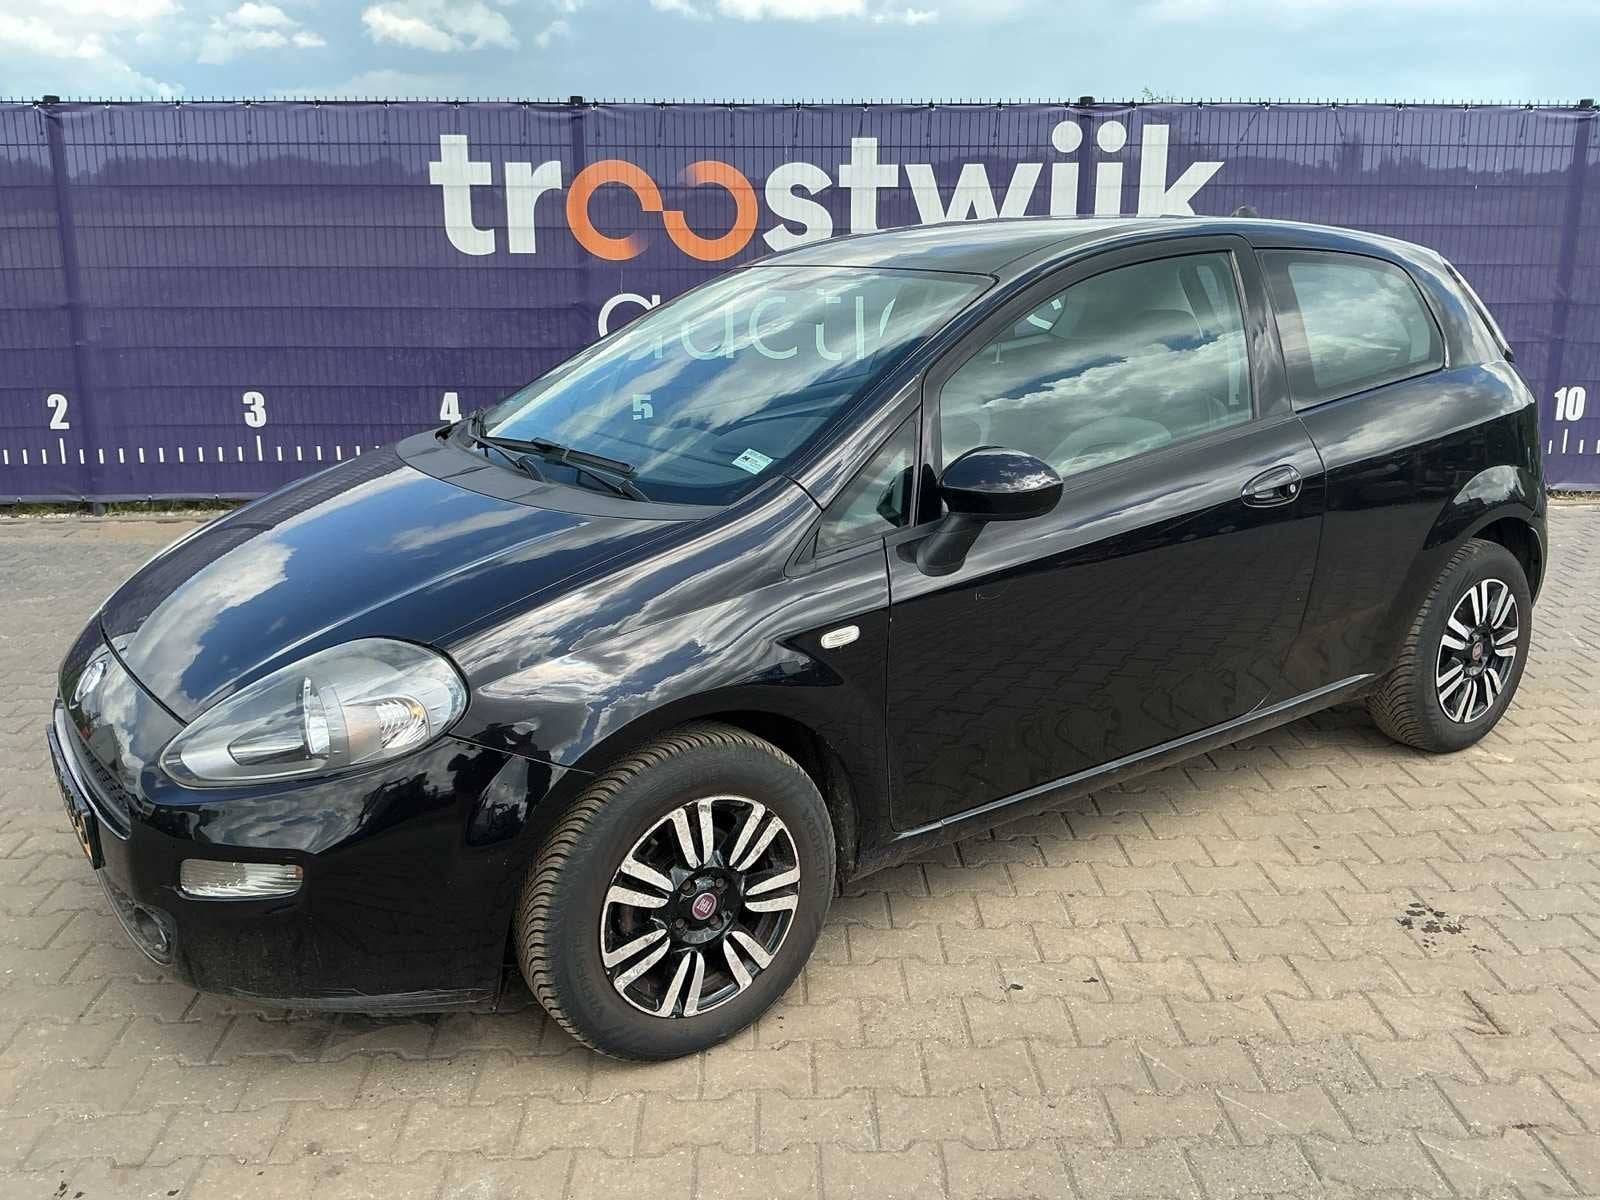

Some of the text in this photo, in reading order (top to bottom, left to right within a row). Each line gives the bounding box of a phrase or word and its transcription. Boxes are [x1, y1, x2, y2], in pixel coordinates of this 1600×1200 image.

[598, 288, 896, 361] aucti
[47, 386, 1586, 430] 2 3 4 5 10
